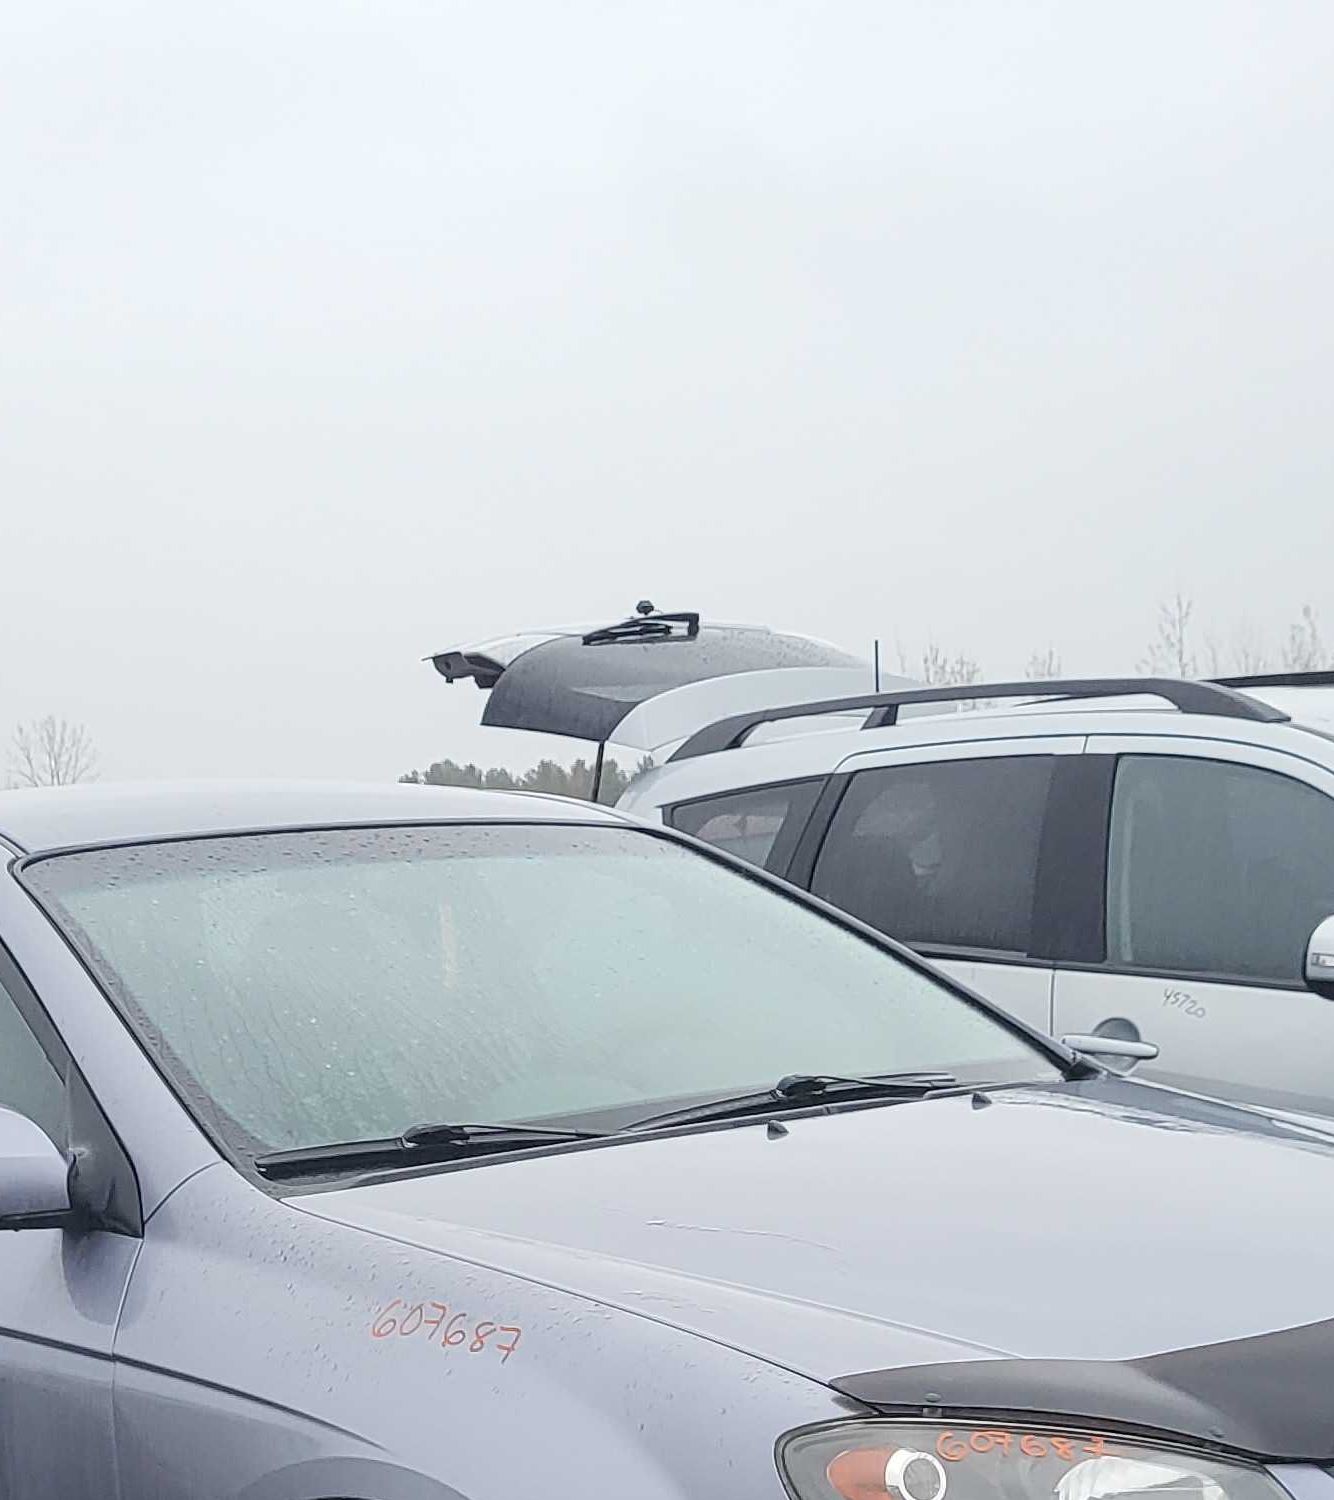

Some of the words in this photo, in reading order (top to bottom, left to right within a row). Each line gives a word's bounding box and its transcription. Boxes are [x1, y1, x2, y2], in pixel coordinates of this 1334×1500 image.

[1164, 987, 1207, 1019] 45720
[371, 1300, 522, 1365] 607687
[936, 1428, 1106, 1463] 607687
